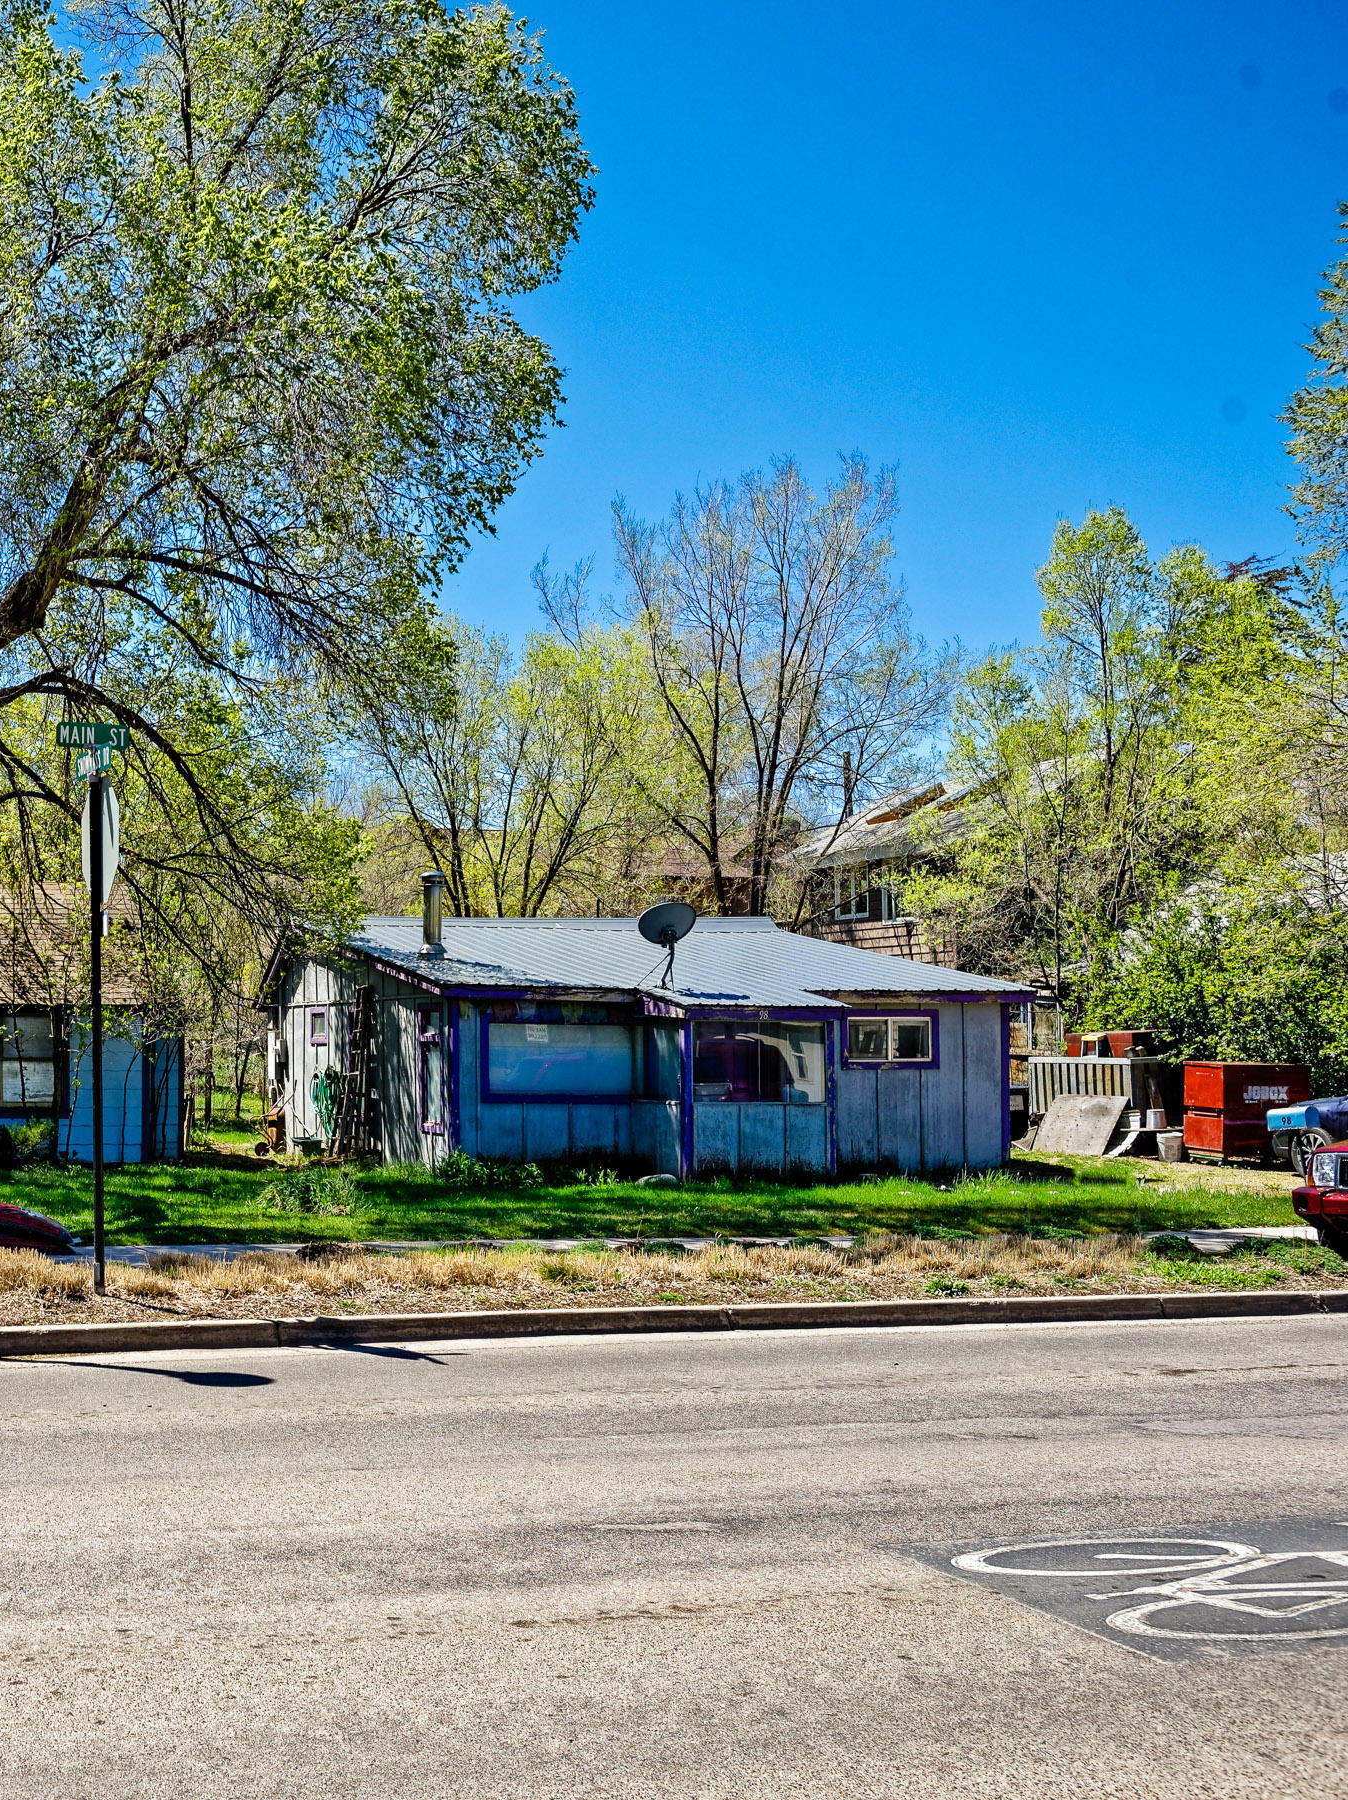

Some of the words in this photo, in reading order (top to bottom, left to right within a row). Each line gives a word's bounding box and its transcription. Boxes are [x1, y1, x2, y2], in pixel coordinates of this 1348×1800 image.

[60, 725, 95, 744] MAIN
[110, 728, 126, 747] ST
[759, 1010, 769, 1020] 98
[1243, 1085, 1290, 1100] JOBOX
[1281, 1116, 1292, 1125] 98
